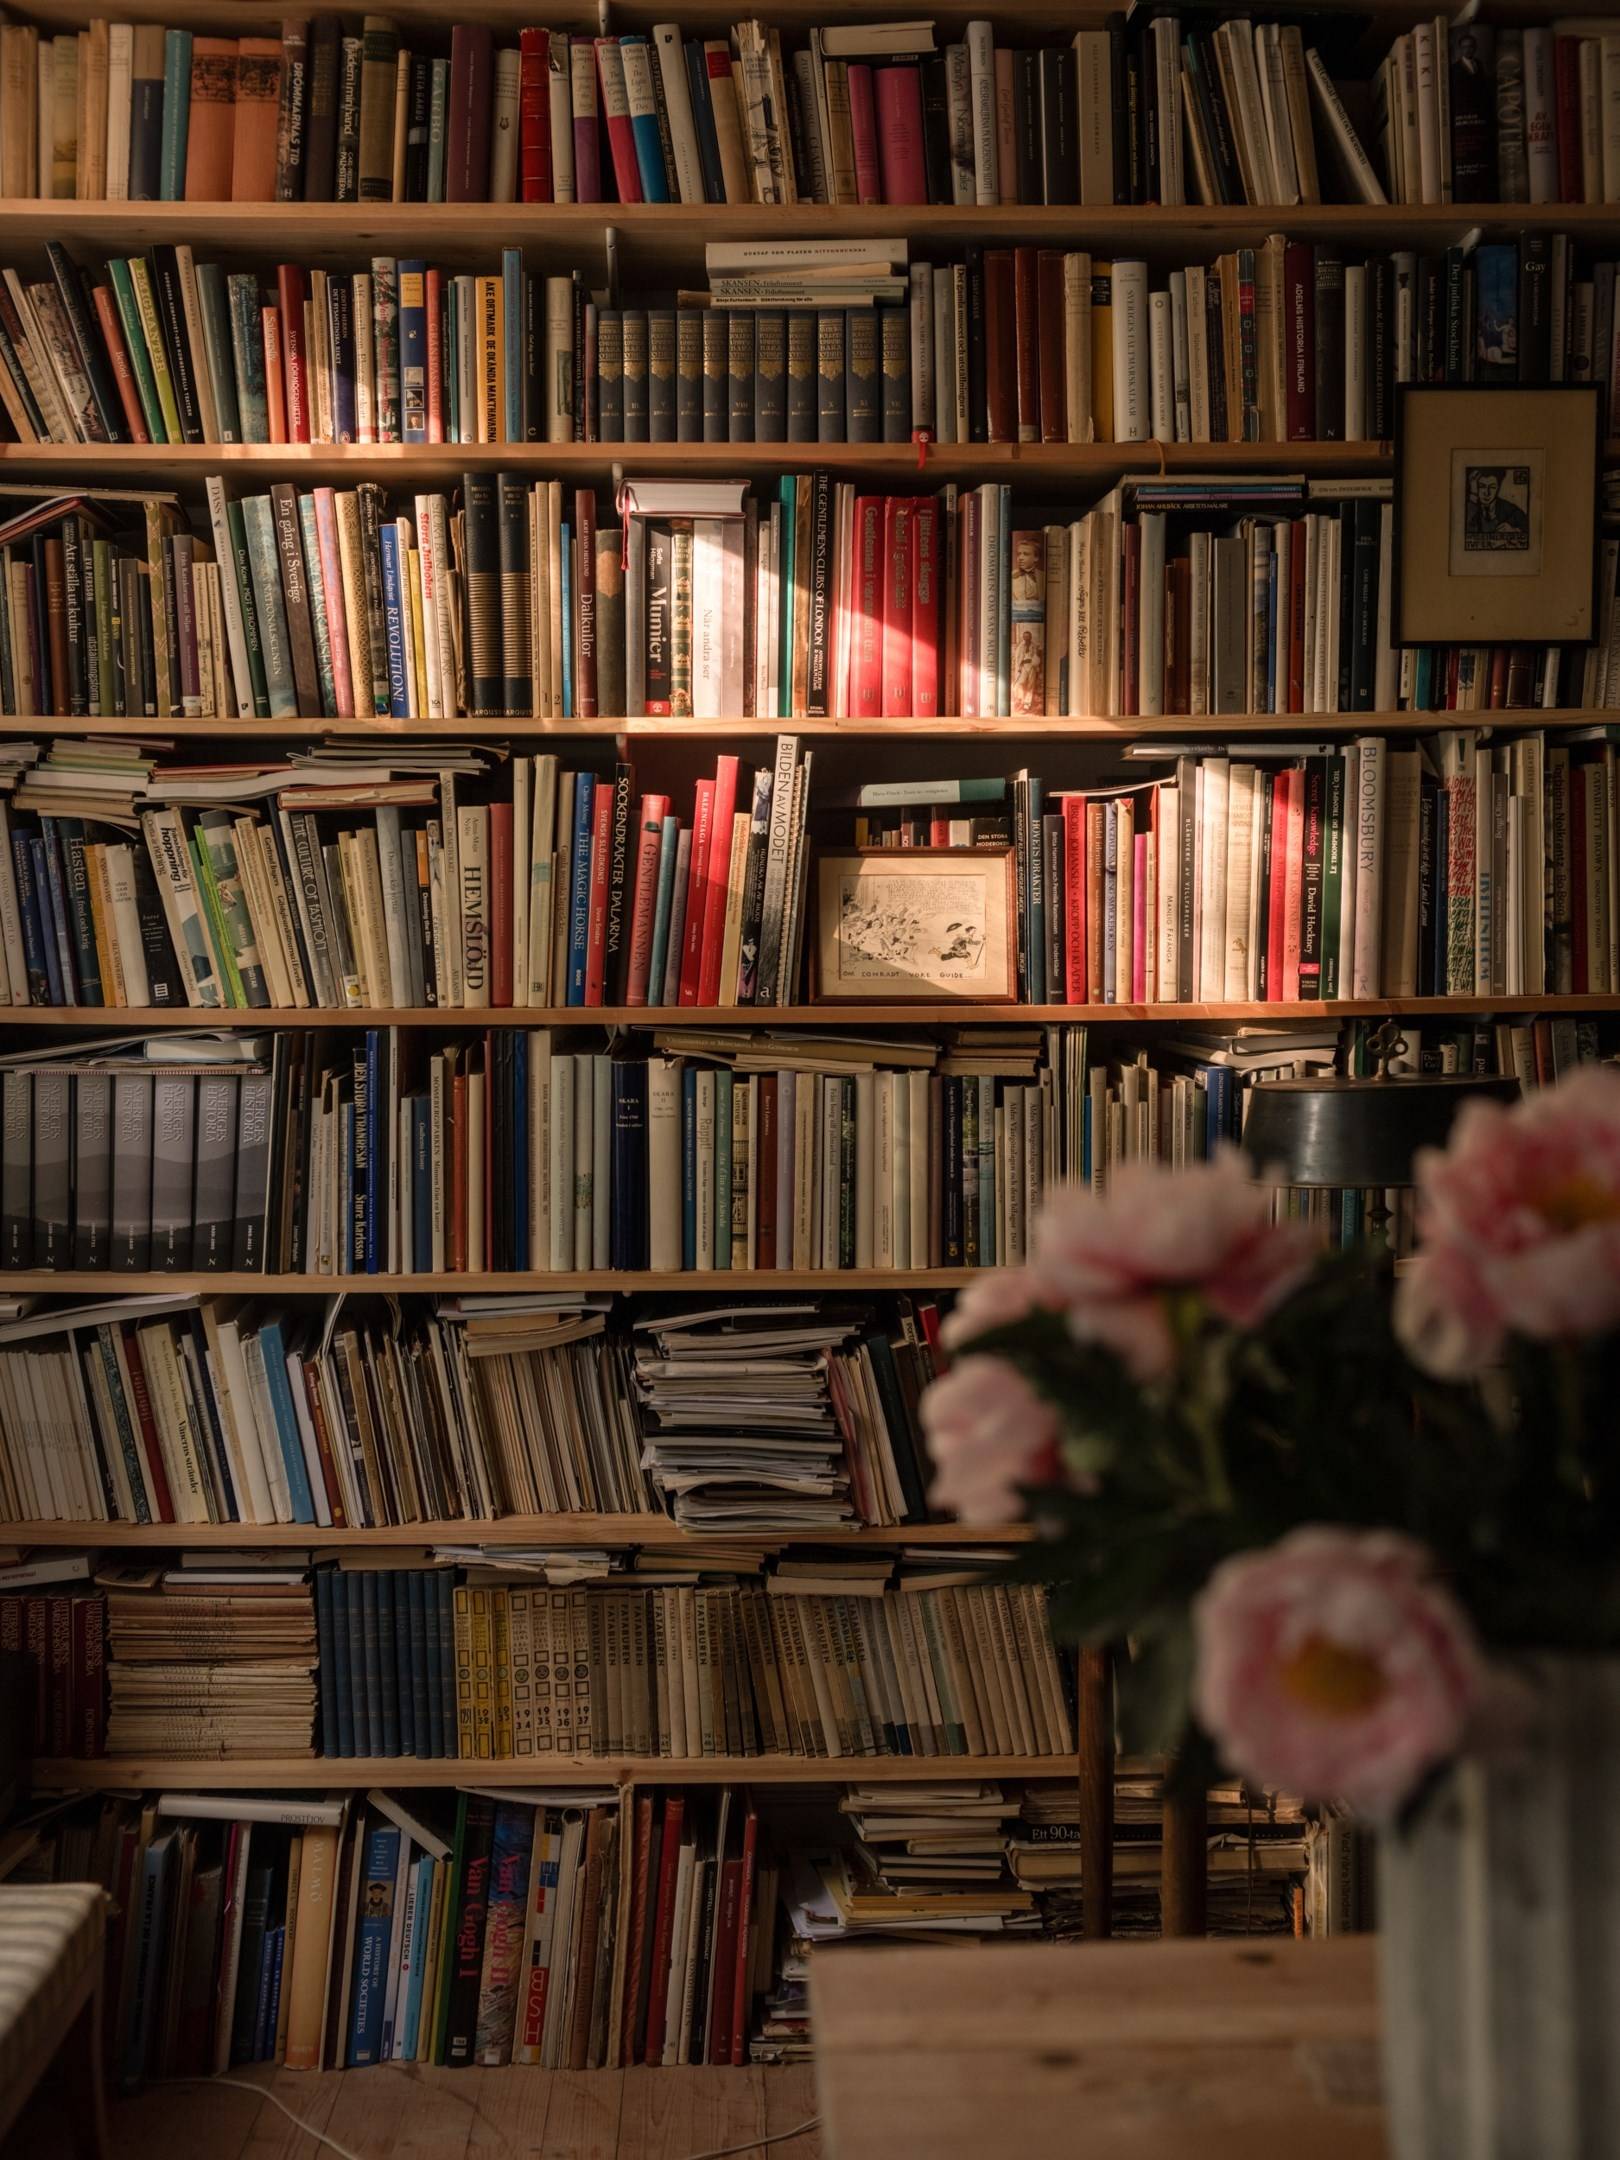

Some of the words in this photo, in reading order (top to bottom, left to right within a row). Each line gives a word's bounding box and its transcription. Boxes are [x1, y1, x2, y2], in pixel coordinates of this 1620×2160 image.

[1497, 57, 1523, 154] CAPOTE
[290, 147, 301, 166] TID
[957, 268, 966, 281] Det
[486, 299, 497, 337] ORTMARK
[1295, 283, 1304, 315] ADELNS
[486, 339, 496, 350] DE
[1296, 316, 1305, 354] HISTORIA
[1449, 319, 1461, 370] Stockholm
[486, 351, 497, 383] OKÄNDA
[1296, 359, 1305, 393] FINLAND
[486, 384, 497, 443] MAKTHAVARNA
[817, 475, 828, 493] THE
[280, 498, 292, 515] En
[65, 542, 78, 561] Att
[279, 519, 294, 550] gång
[66, 563, 80, 592] ställa
[86, 571, 94, 602] PERSSON
[287, 559, 303, 603] Sverige
[814, 559, 826, 589] CLUBS
[68, 593, 78, 605] ut
[813, 590, 825, 604] OF
[68, 606, 81, 644] kultur
[580, 593, 594, 658] Dalkullor
[649, 586, 667, 663] Mumier
[813, 604, 825, 645] LONDON
[387, 606, 404, 702] REVOLUTION!
[702, 630, 713, 663] andra
[703, 663, 713, 680] ser
[779, 743, 794, 793] BILDEN
[698, 791, 710, 843] BALENCIAGA
[776, 795, 785, 810] AV
[1360, 747, 1377, 873] BLOOMSBURY
[1594, 770, 1603, 829] CAPABILITY
[292, 818, 306, 839] THE
[599, 809, 608, 837] SVENSK
[612, 777, 630, 885] SOCKENDRÄKTER
[771, 812, 787, 864] MODET
[1032, 819, 1042, 857] HOVETS
[1308, 804, 1320, 856] Knowledge
[160, 827, 182, 882] hoppning
[295, 841, 313, 880] CULTURE
[578, 829, 589, 856] THE
[1069, 804, 1080, 889] BROBY-JOHANSEN
[1595, 834, 1603, 873] BROWN
[575, 861, 588, 905] MAGIC
[1032, 859, 1042, 904] DRÄKTER
[1307, 887, 1317, 914] David
[607, 890, 623, 952] DALARNA
[634, 843, 657, 971] GENTLEMANNEN
[1069, 898, 1080, 929] KROPP
[307, 903, 327, 951] FASHION
[464, 866, 487, 990] HEMSLÖJD
[574, 907, 586, 950] HORSE
[1070, 931, 1080, 953] OCH
[1304, 916, 1316, 954] Hockney
[1070, 955, 1082, 993] KLÄDER
[354, 1062, 367, 1083] DEN
[217, 1085, 228, 1142] SVERIGES
[255, 1087, 265, 1142] SVERIGES
[354, 1083, 367, 1113] STORA
[355, 1114, 368, 1168] TRANRESAN
[697, 1118, 712, 1150] Rappt!
[355, 1193, 366, 1218] Sture
[354, 1220, 366, 1260] Karlsson
[176, 1420, 192, 1457] Vänerns
[182, 1457, 200, 1495] stränder
[655, 1606, 664, 1666] FATABUREN
[696, 1604, 706, 1665] FATABUREN
[466, 1856, 488, 1896] Van
[406, 1893, 415, 1920] LIEBER
[403, 1923, 413, 1960] DEUTSCH
[457, 1901, 481, 1960] Gogh
[361, 1936, 372, 1976] WORLD
[357, 1978, 369, 2034] SOCIETIES
